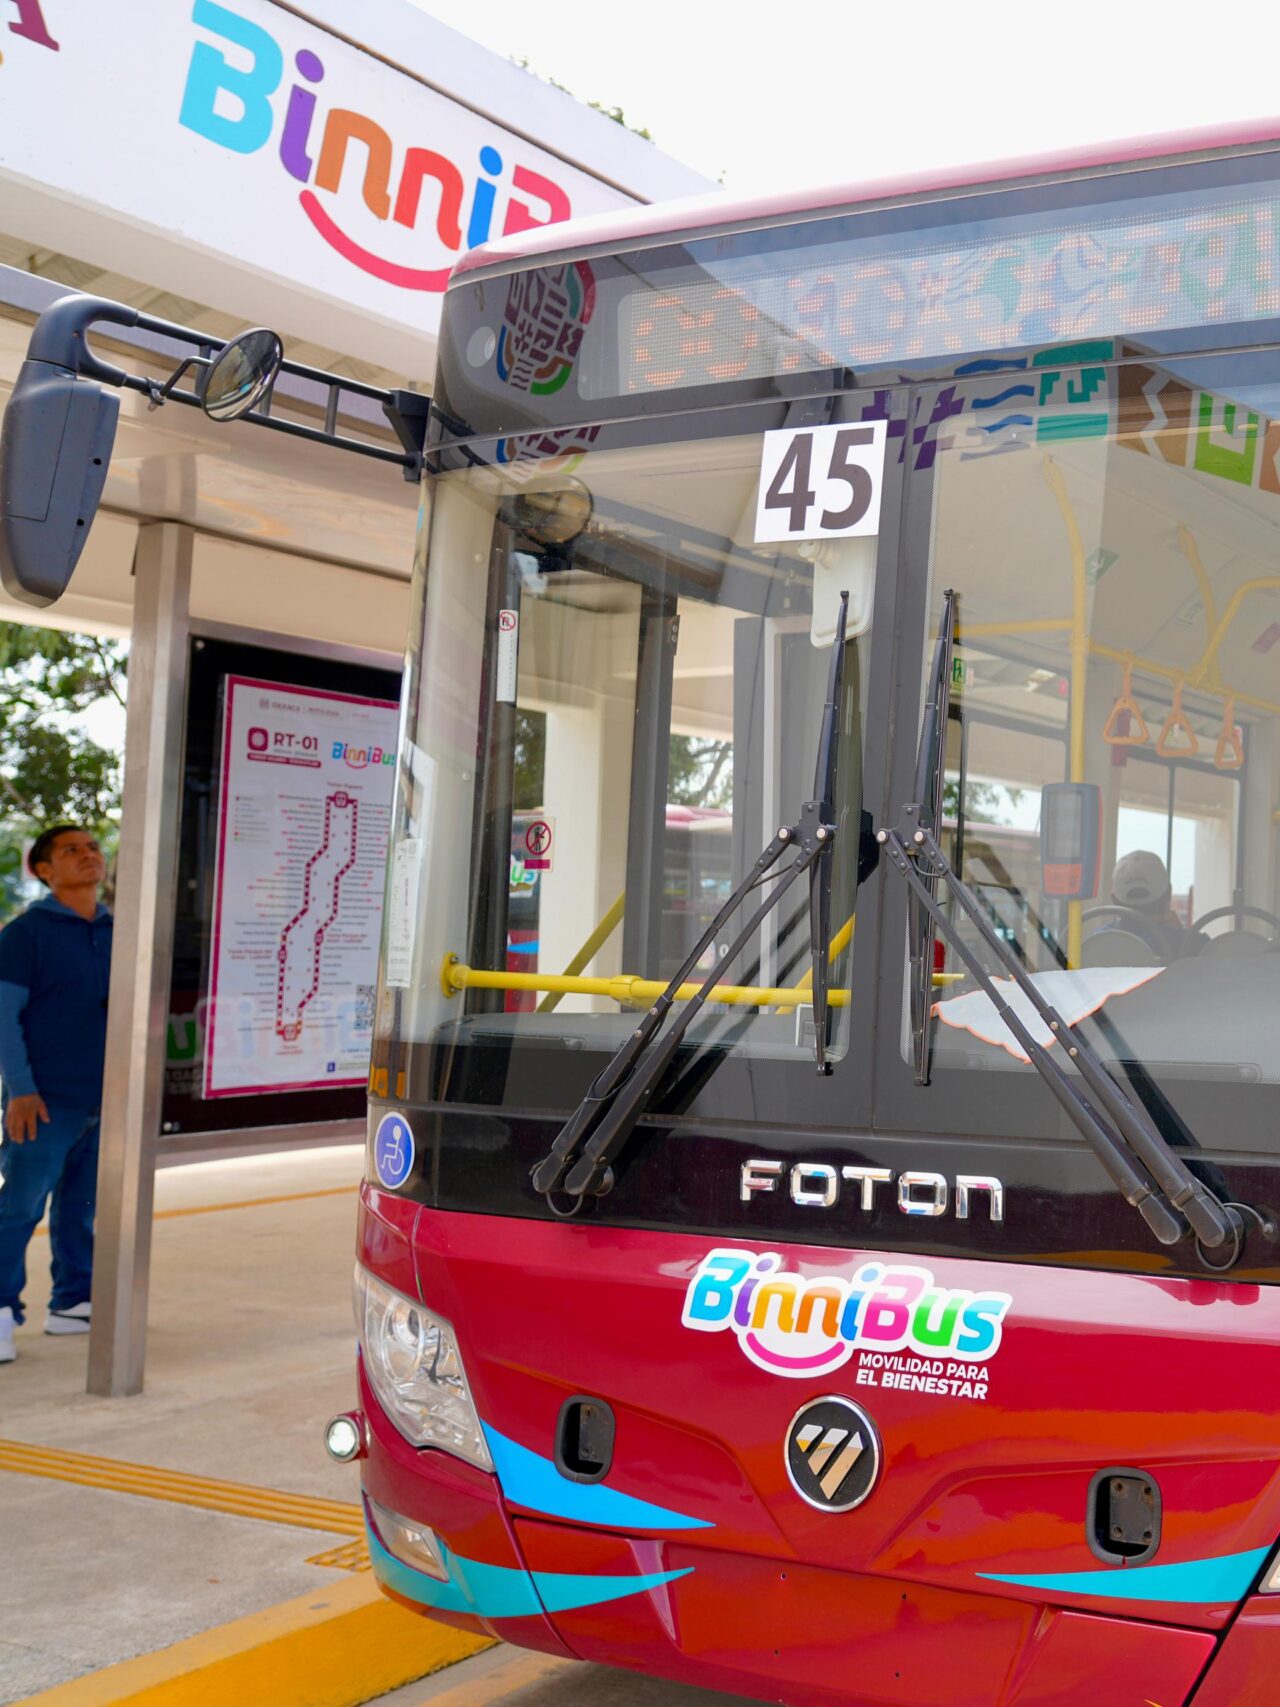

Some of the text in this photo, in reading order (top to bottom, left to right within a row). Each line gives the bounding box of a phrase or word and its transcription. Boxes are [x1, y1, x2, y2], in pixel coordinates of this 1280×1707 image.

[764, 427, 875, 532] 45
[274, 732, 318, 750] RT-01
[738, 1159, 1004, 1221] FOTON
[858, 1352, 989, 1381] MOVILIDAD PARA
[855, 1368, 988, 1400] EL BIENESTAR
